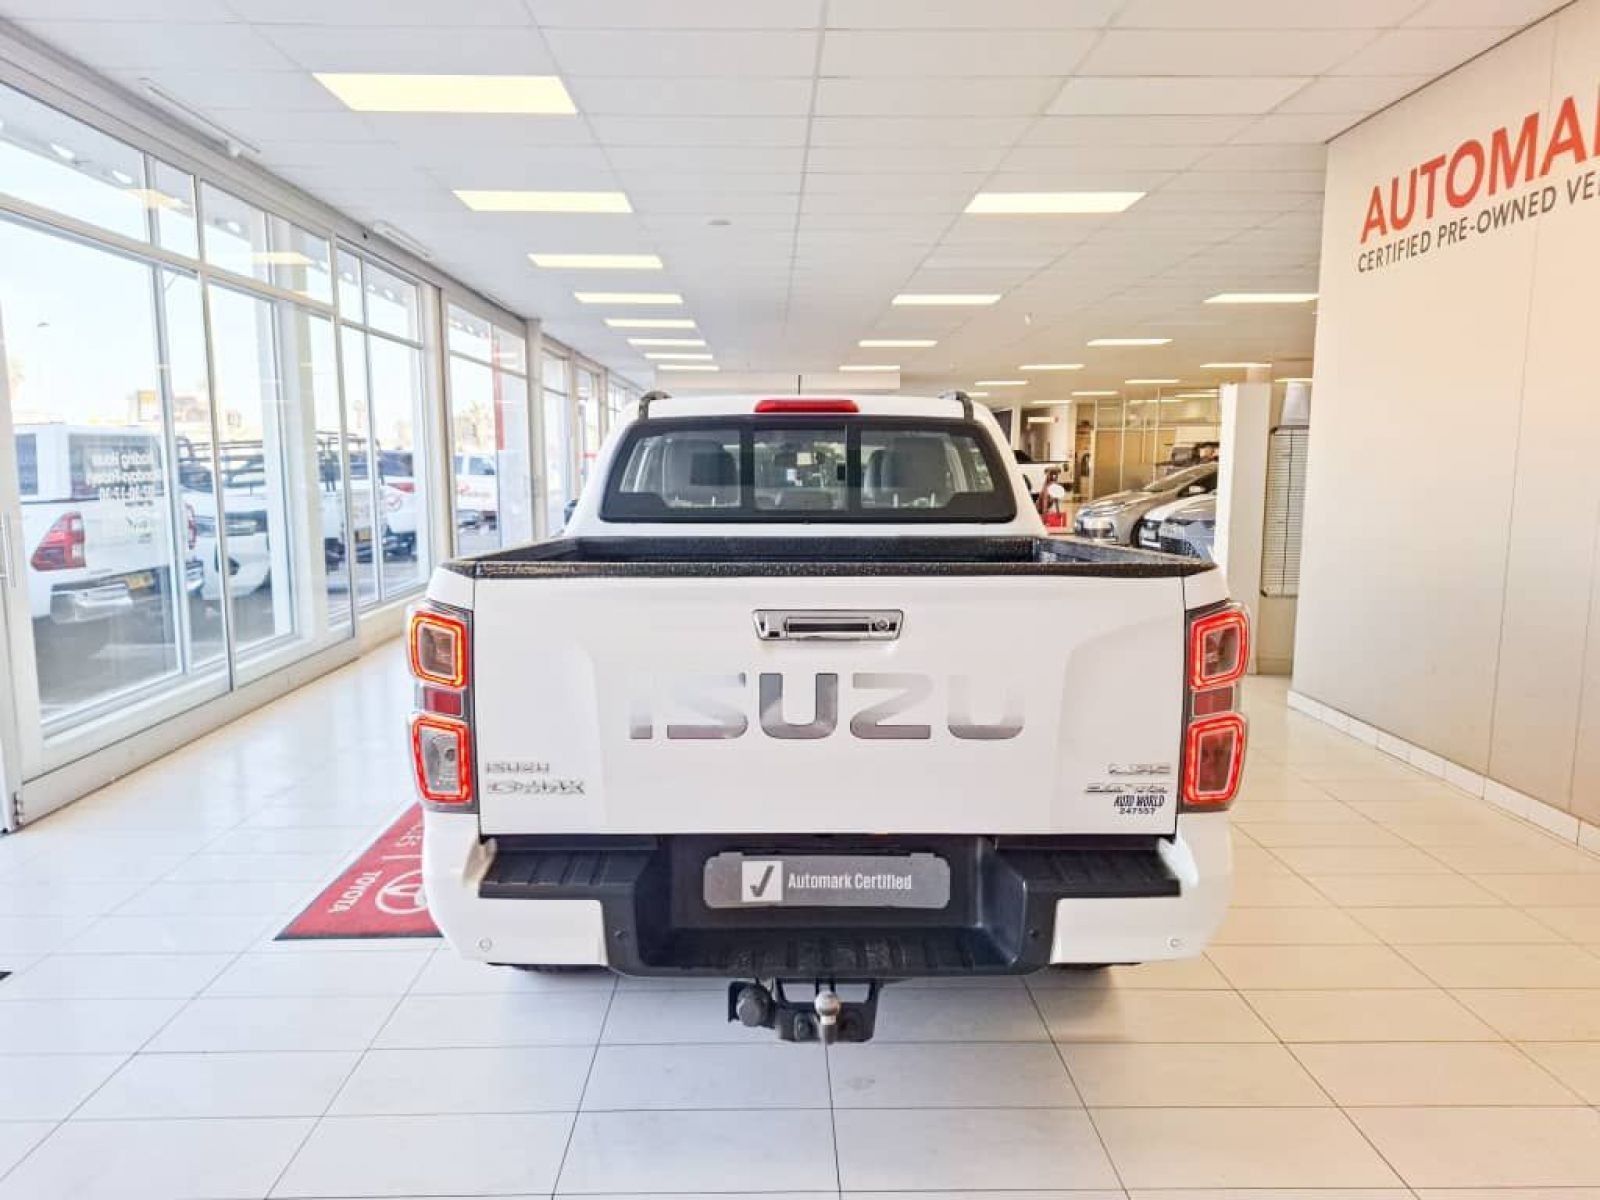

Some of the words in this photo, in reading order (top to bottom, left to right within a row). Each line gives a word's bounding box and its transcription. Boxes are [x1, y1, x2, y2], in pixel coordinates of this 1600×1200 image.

[1357, 230, 1431, 273] CERTIFIED
[1436, 185, 1557, 249] PRE-OWNED
[1566, 170, 1600, 205] VE
[629, 672, 1025, 740] ISUZU
[1113, 794, 1135, 807] AUTO
[1136, 794, 1166, 807] WORLD
[328, 869, 384, 914] TOYOTA
[788, 872, 852, 889] Automark
[854, 873, 913, 890] Certified
